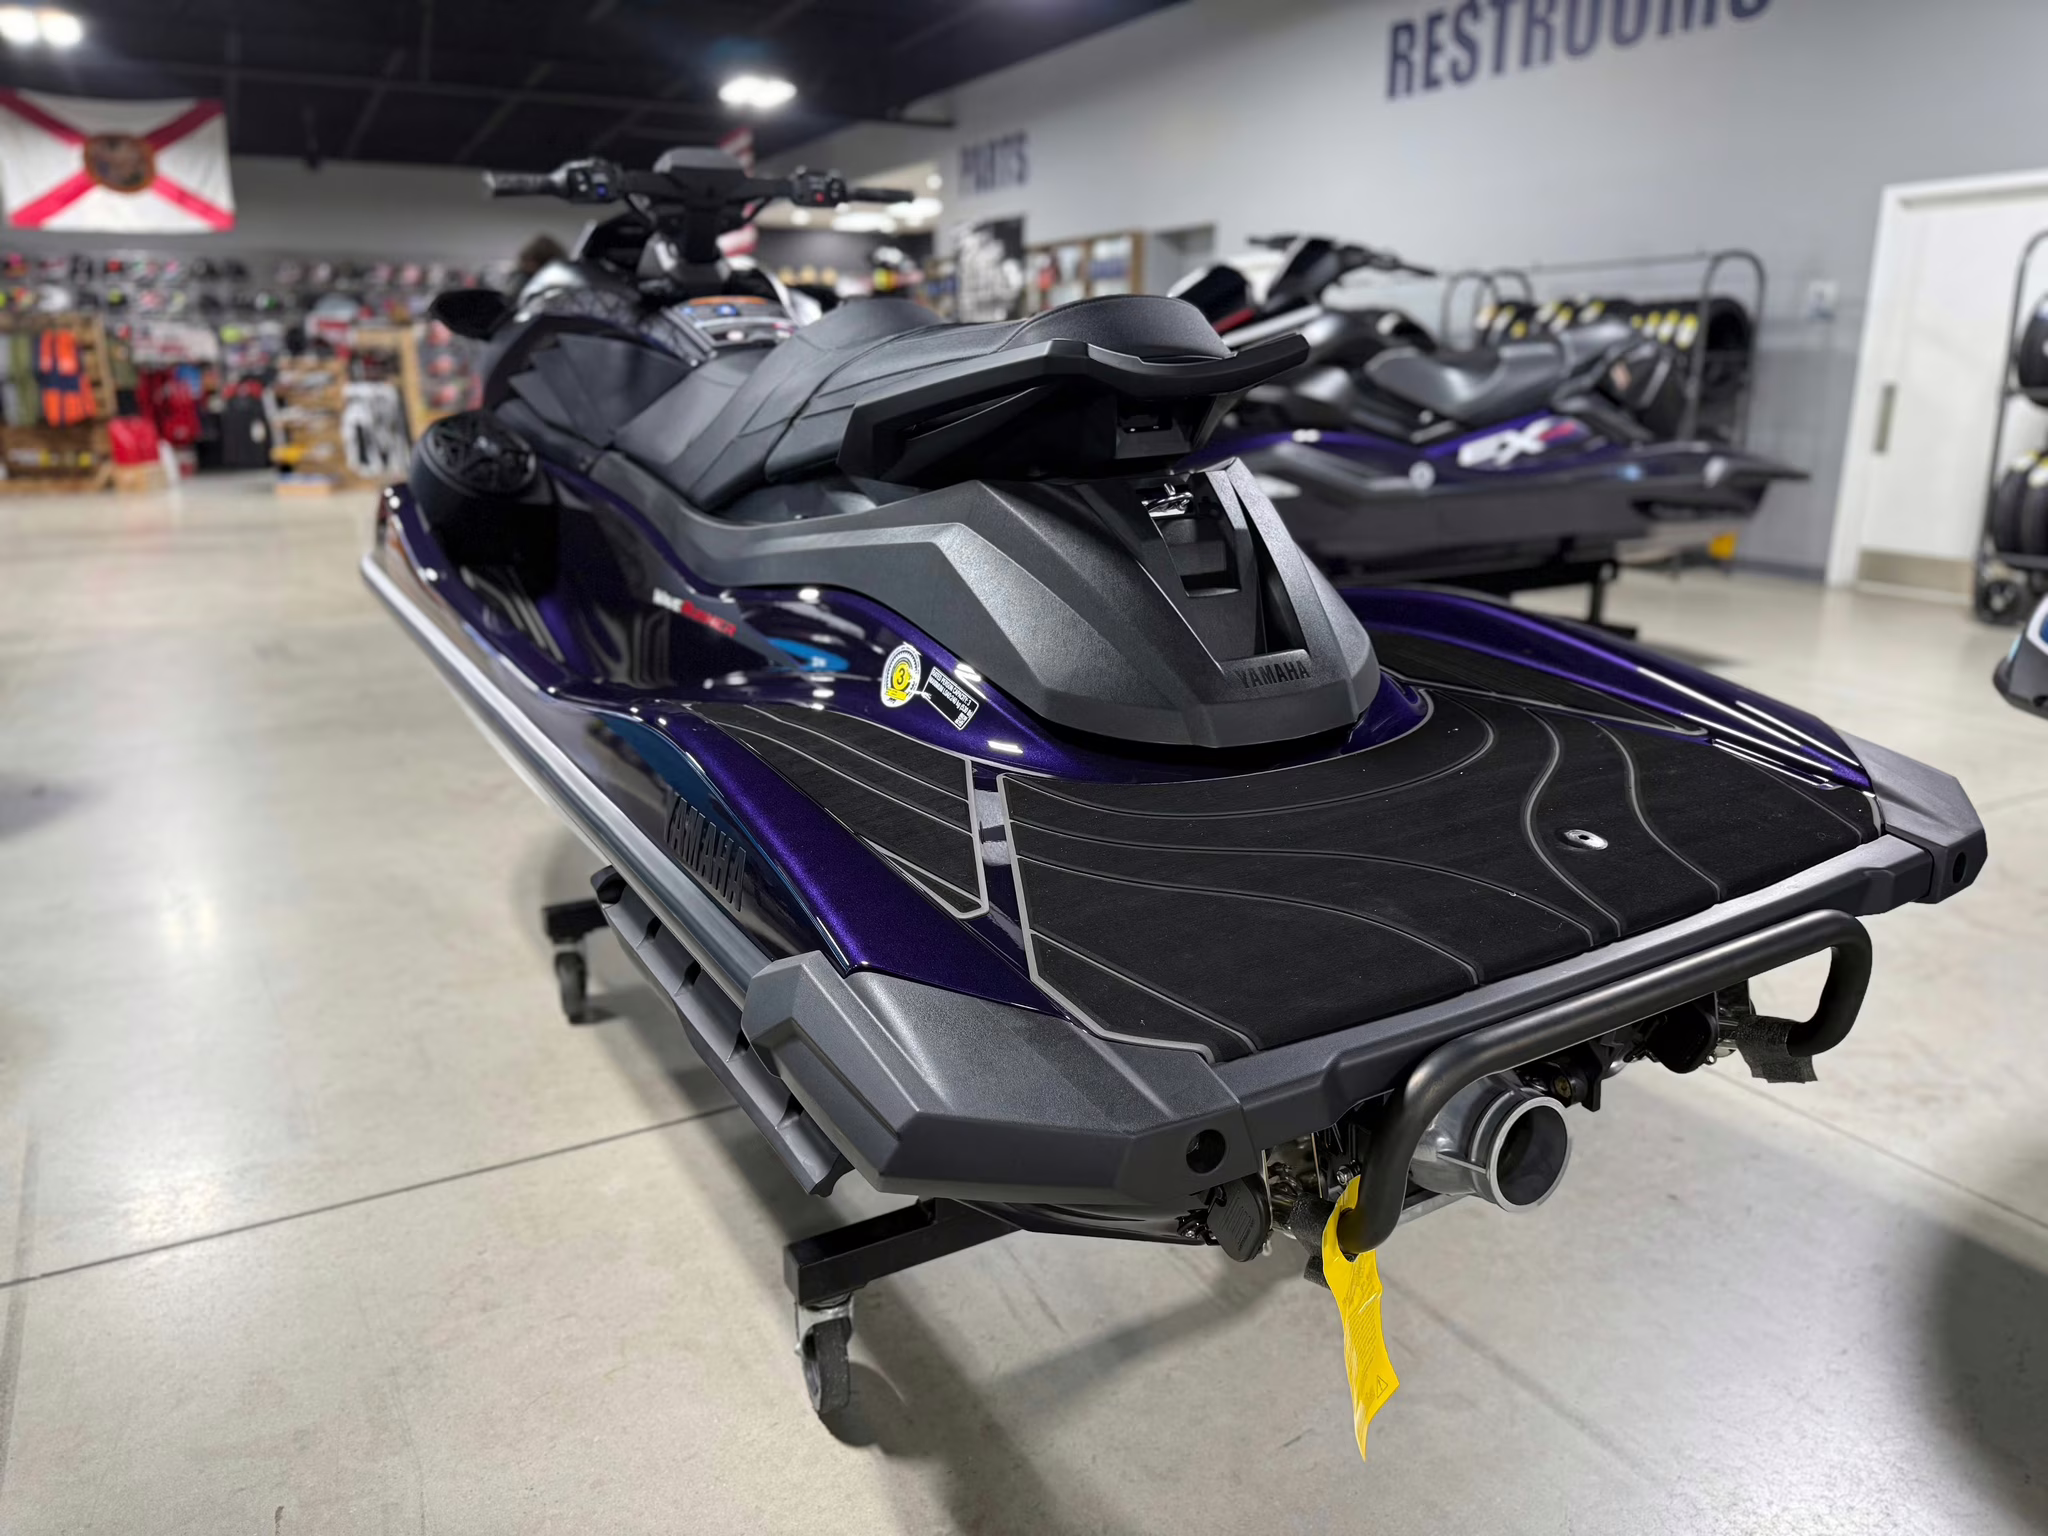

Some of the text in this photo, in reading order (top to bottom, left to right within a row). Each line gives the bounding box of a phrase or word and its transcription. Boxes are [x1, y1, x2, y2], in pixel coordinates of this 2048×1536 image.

[1386, 0, 1772, 98] RESTROO
[896, 667, 906, 685] 3
[1234, 661, 1311, 689] YAMAHA
[664, 790, 746, 912] YAMAHA
